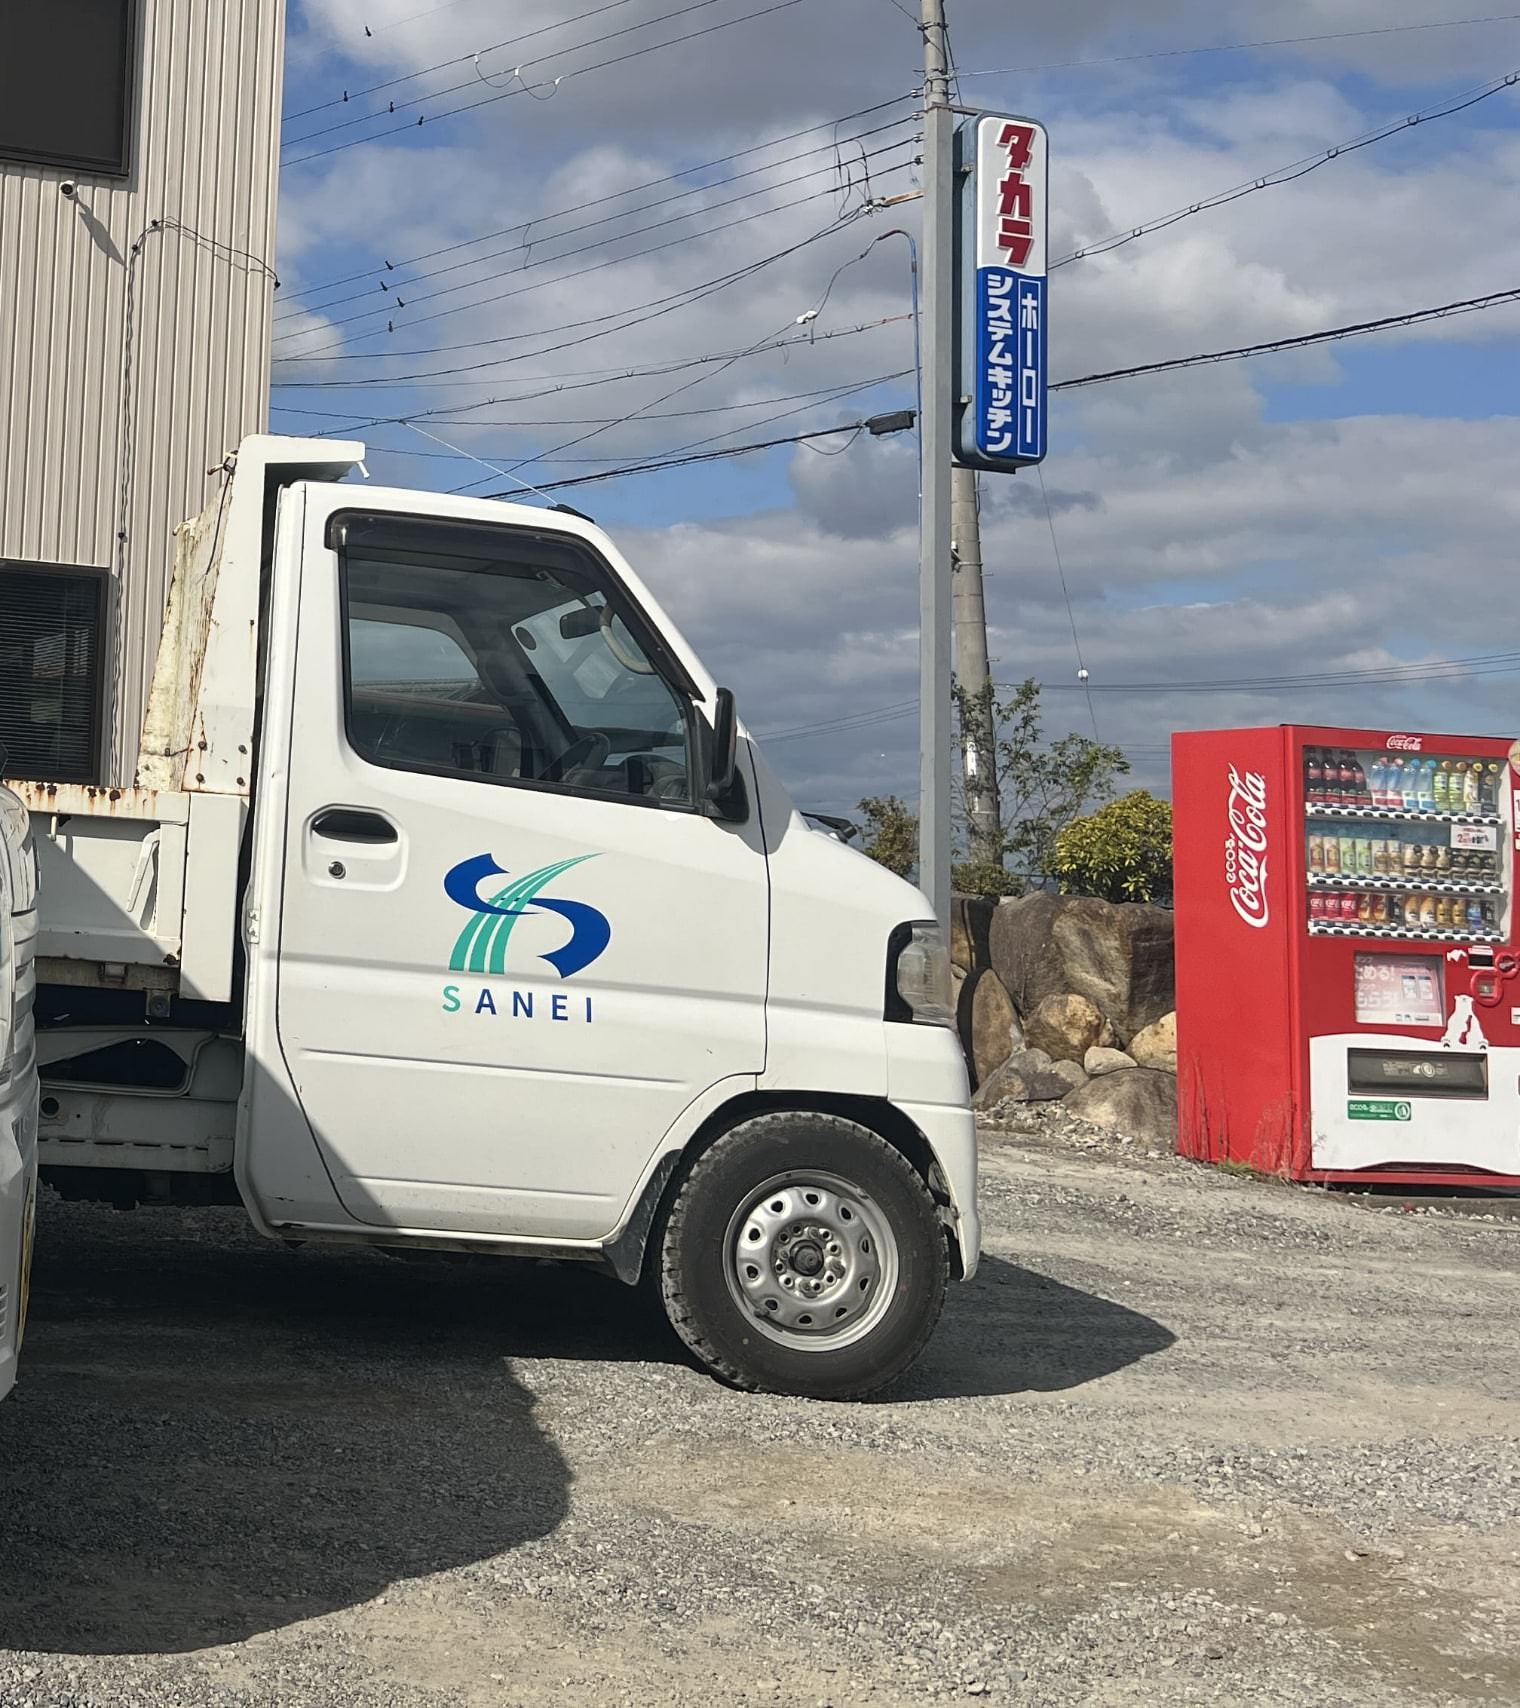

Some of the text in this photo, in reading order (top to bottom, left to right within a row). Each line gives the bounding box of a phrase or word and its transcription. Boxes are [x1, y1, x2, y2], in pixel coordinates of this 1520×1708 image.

[996, 123, 1037, 267] タカラ
[986, 274, 1014, 452] システムキッチン
[1021, 293, 1038, 443] ホーロー
[1228, 762, 1269, 928] Coca-Cola
[442, 985, 592, 1023] SANEI
